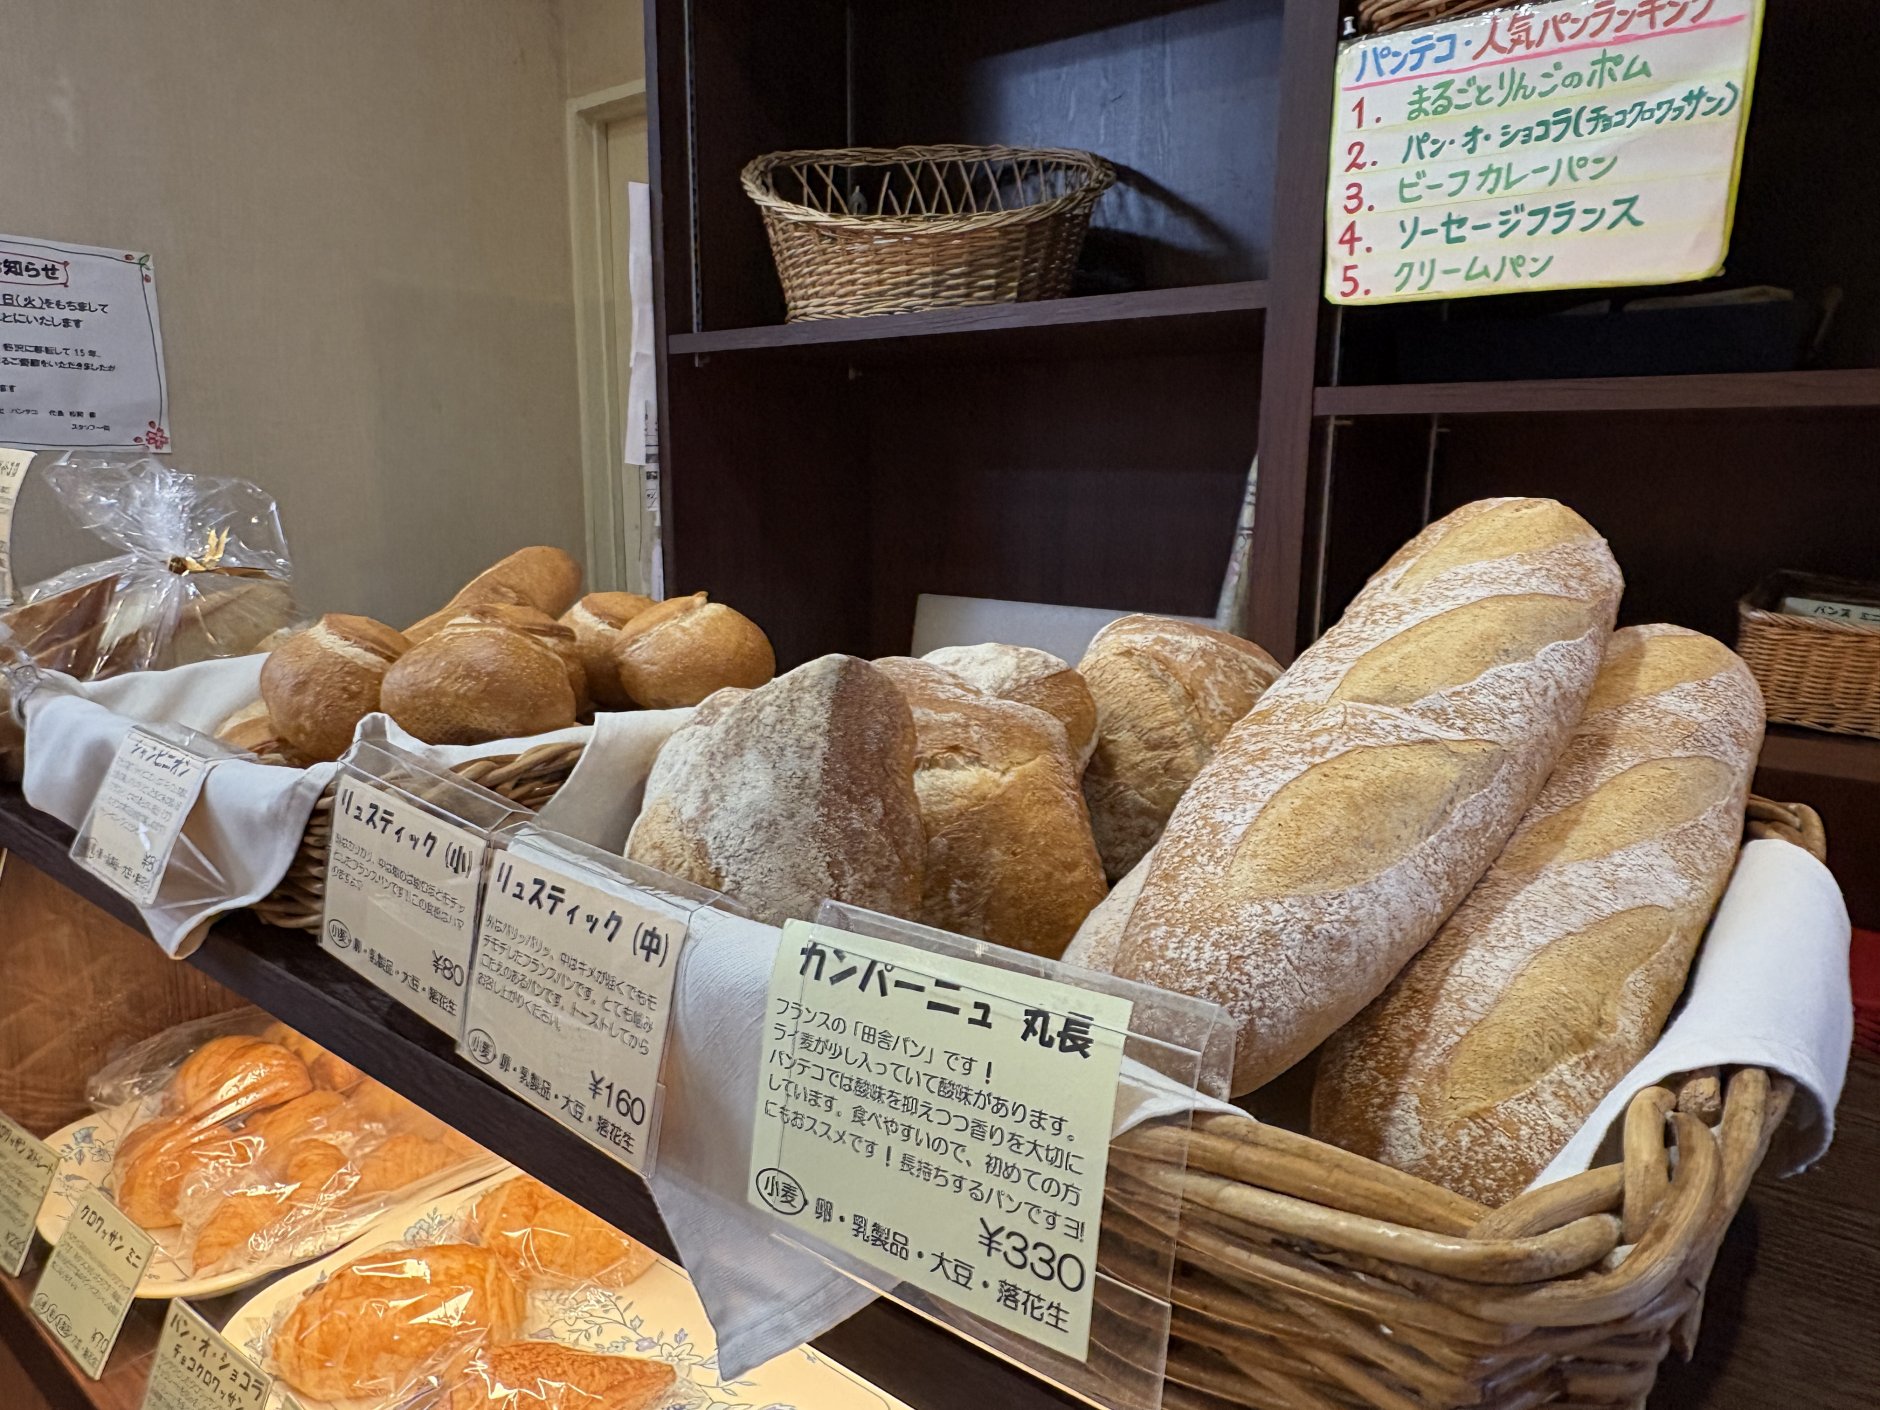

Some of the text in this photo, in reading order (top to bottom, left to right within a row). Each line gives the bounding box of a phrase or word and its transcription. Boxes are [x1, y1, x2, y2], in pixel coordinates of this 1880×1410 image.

[1352, 97, 1382, 129] 1.
[1344, 156, 1618, 214] 3. ビーフカレーパン
[1345, 141, 1378, 172] 2.
[1339, 195, 1644, 256] 4. ソーセージフランス
[1340, 255, 1554, 297] 5. クリームパン
[340, 786, 438, 861] リュスティック
[495, 861, 623, 944] リュスティック
[631, 919, 671, 970] (中)
[797, 939, 1095, 1060] カンパーニュ 丸長
[587, 1069, 647, 1129] ¥160
[976, 1217, 1087, 1296] ¥330
